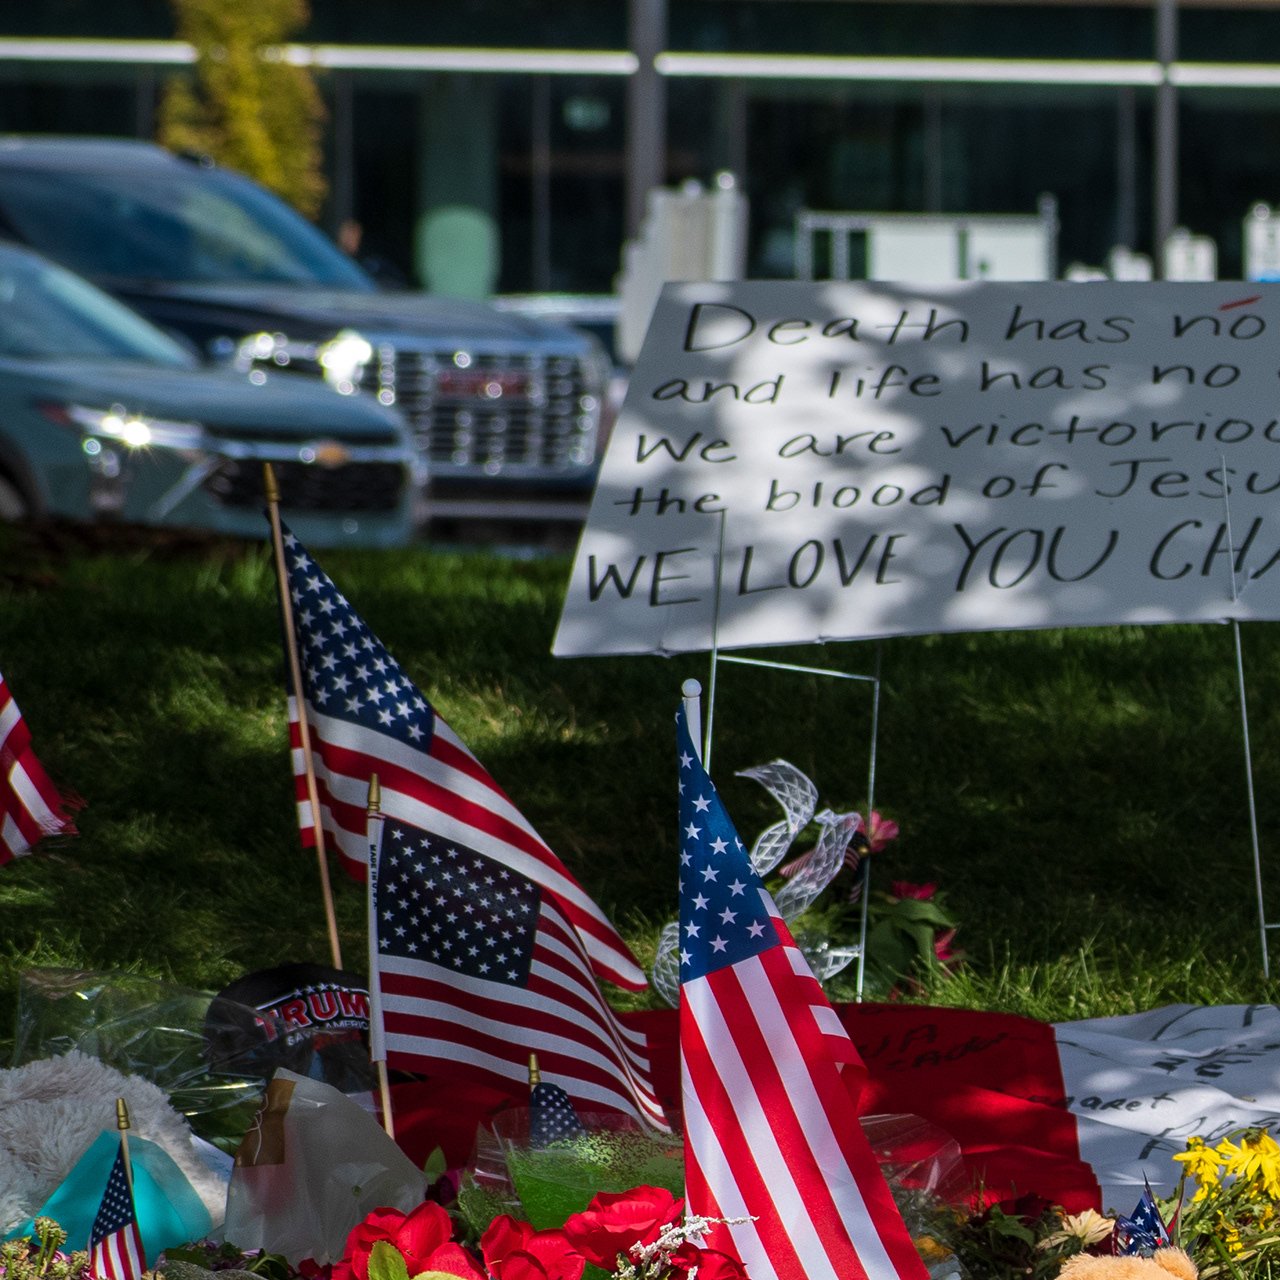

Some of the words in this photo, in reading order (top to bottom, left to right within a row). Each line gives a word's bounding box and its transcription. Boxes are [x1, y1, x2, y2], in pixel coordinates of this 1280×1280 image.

[682, 302, 969, 353] Death
[1004, 305, 1135, 344] has
[651, 375, 786, 405] and
[829, 365, 942, 399] life
[980, 361, 1111, 392] has
[1153, 363, 1241, 388] no
[778, 427, 902, 458] are
[614, 487, 723, 516] the
[765, 475, 951, 511] blood
[983, 464, 1068, 498] of
[588, 548, 701, 607] WE
[739, 534, 907, 596] LOVE
[952, 523, 1120, 593] YOU
[369, 844, 377, 869] MADE
[371, 871, 378, 881] IN
[255, 991, 371, 1042] TRUM
[325, 1020, 370, 1031] AMERIC
